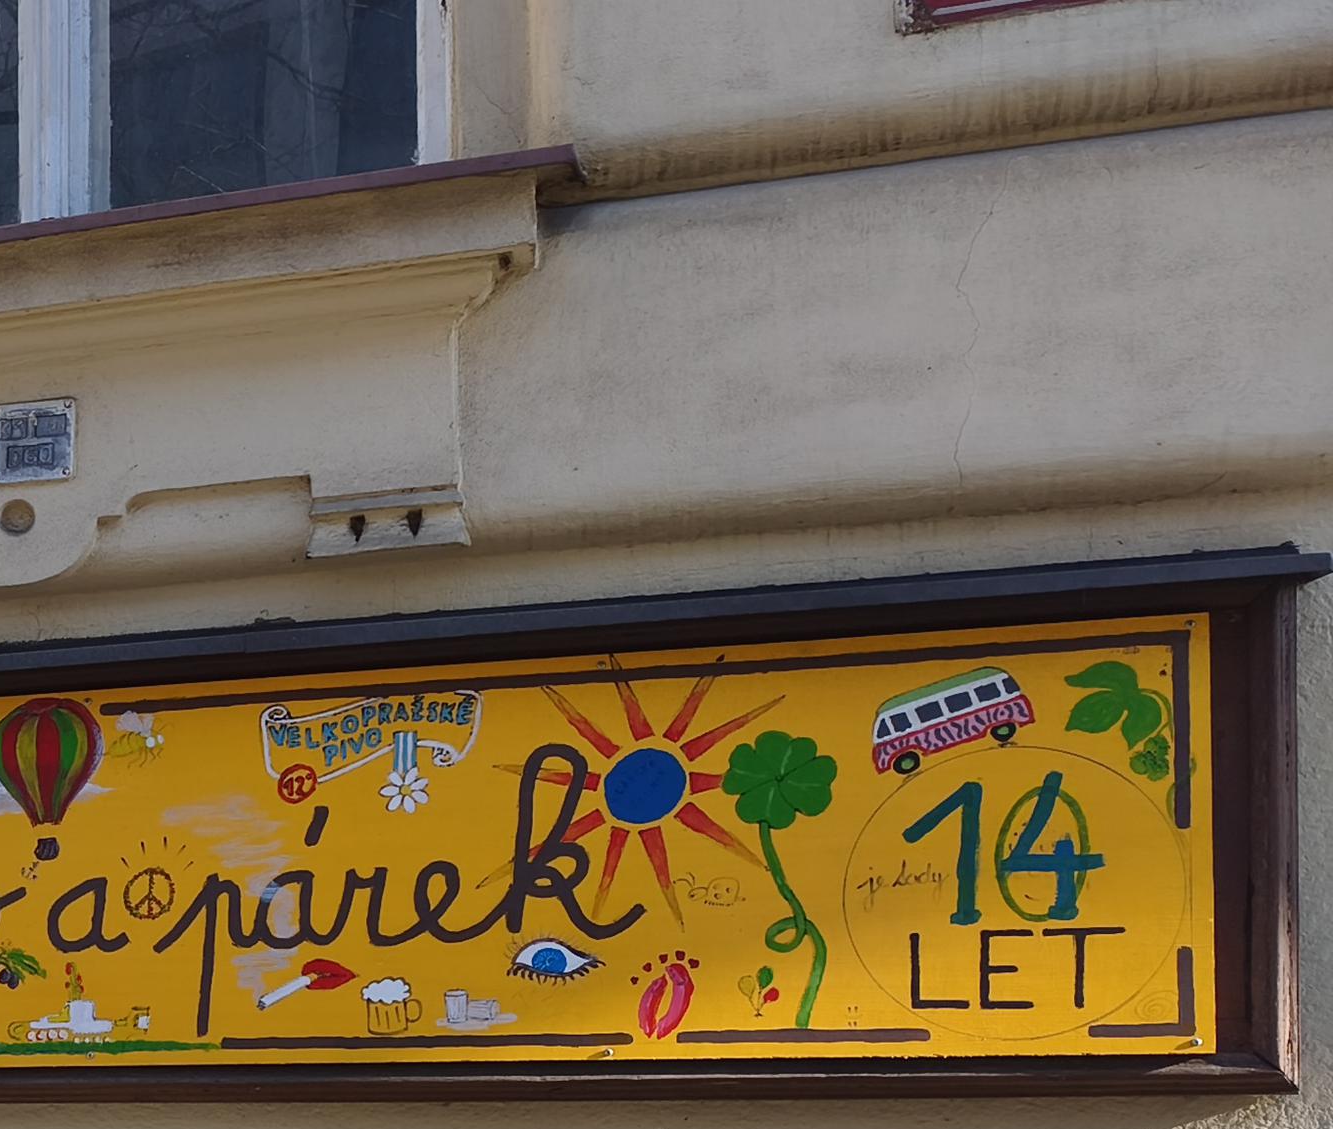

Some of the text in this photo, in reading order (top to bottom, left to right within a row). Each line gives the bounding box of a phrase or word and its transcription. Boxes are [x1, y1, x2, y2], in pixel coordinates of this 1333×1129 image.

[268, 694, 475, 749] VELKOPRAŽSKÉ
[323, 728, 382, 767] PIVO
[902, 770, 1107, 926] 14
[48, 868, 130, 954] a
[153, 744, 645, 1037] párek
[909, 927, 1126, 1011] LET
